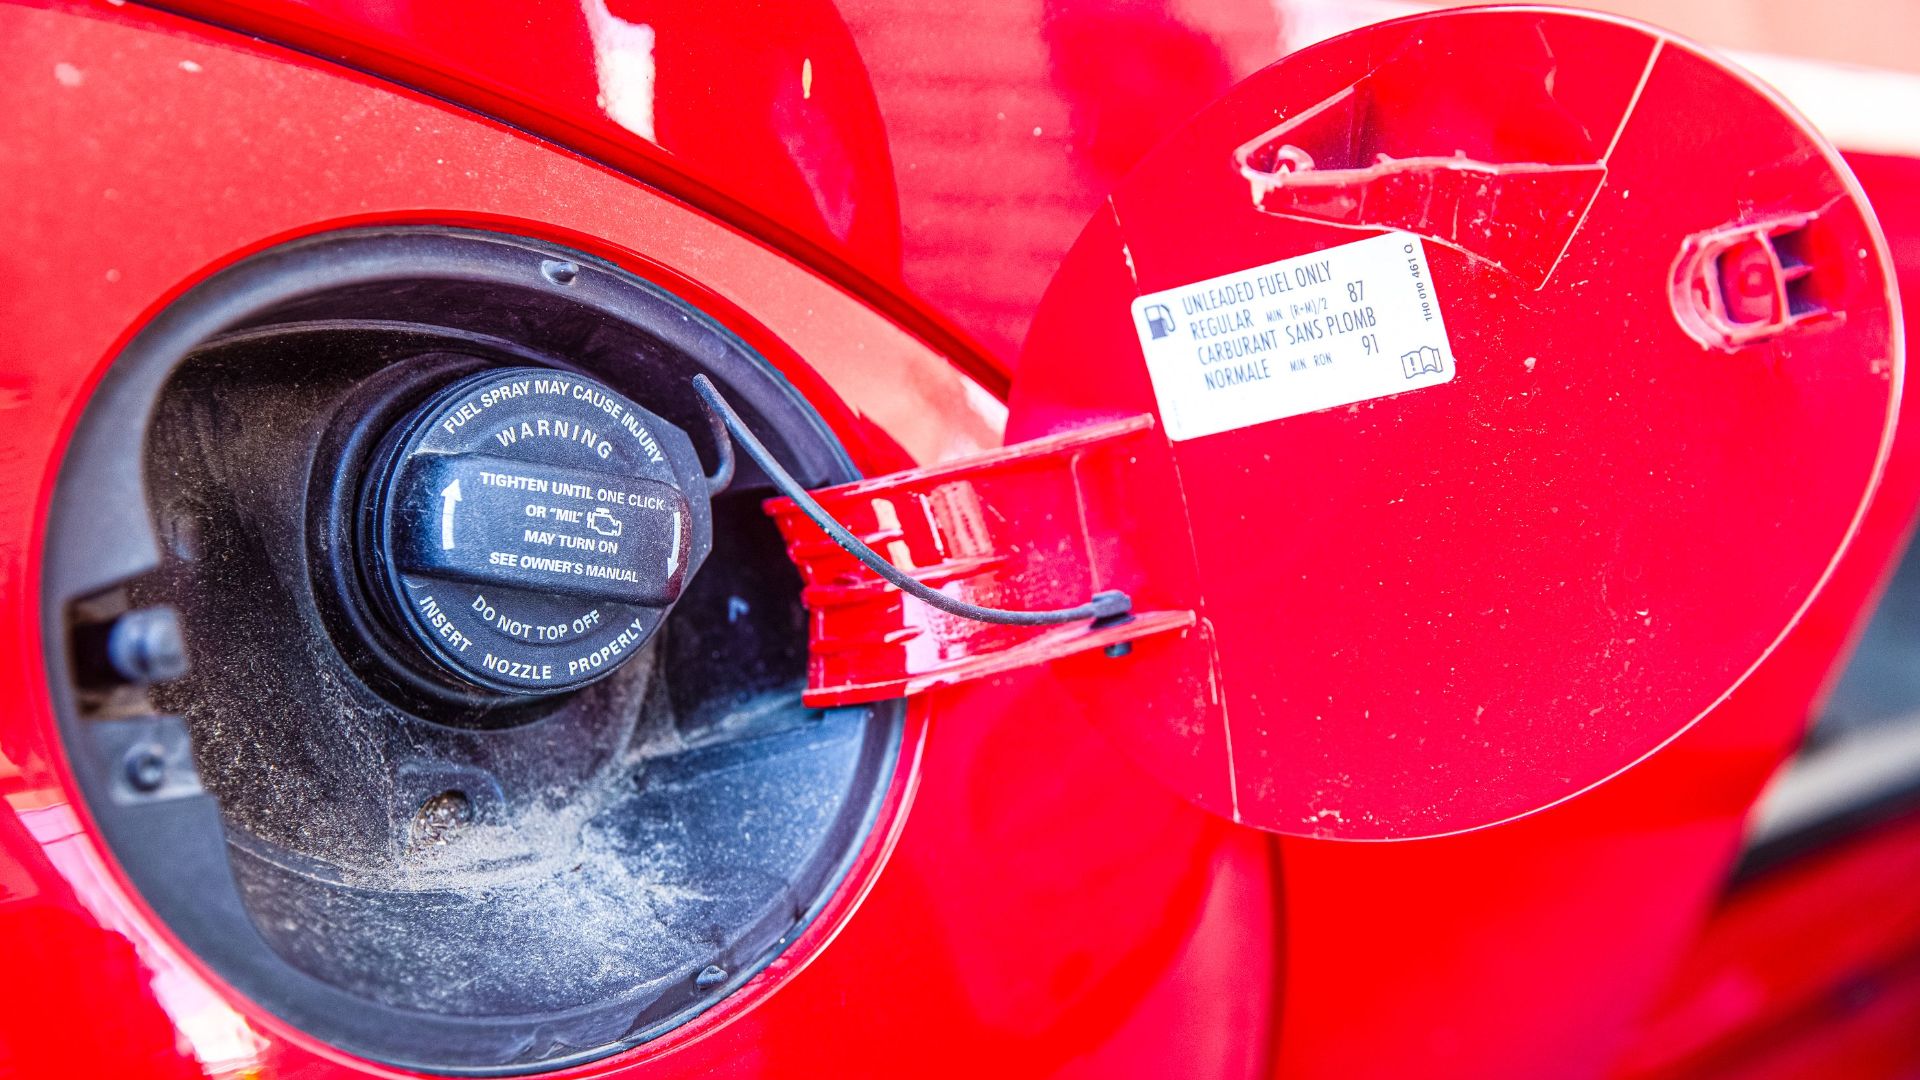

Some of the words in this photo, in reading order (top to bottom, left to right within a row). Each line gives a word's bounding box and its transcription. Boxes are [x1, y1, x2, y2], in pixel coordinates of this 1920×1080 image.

[1404, 243, 1414, 254] Q
[1408, 258, 1420, 278] 461
[1182, 281, 1254, 316] UNLEADED
[1257, 272, 1293, 297] FUEL
[1295, 260, 1333, 287] ONLY
[1416, 282, 1427, 299] 010
[1190, 309, 1254, 340] REGULAR
[1266, 309, 1284, 323] MIN
[1347, 280, 1364, 302] 87
[1197, 330, 1278, 366] CARBURANT
[1285, 319, 1323, 346] SANS
[1326, 306, 1377, 336] PLOMB
[1204, 359, 1271, 390] NORMALE
[1289, 360, 1307, 372] MIN
[1314, 352, 1333, 366] RON
[1361, 334, 1379, 355] 91
[442, 401, 482, 435] FUEL
[480, 381, 530, 408] SPRAY
[535, 380, 571, 396] MAY
[572, 384, 623, 419] CAUSE
[620, 415, 664, 464] INJURY
[496, 419, 613, 459] WARNING
[480, 472, 548, 492] TIGHTEN
[552, 481, 593, 500] UNTIL
[597, 488, 625, 504] ONE
[628, 495, 665, 510] CLICK
[525, 504, 546, 518] OR
[524, 530, 555, 545] MAY
[559, 534, 596, 551] TURN
[598, 541, 618, 554] ON
[489, 552, 518, 567] SEE
[586, 564, 639, 583] MANUAL
[419, 595, 472, 653] INSERT
[482, 653, 552, 680] NOZZLE
[568, 618, 644, 676] PROPERLY
[471, 595, 496, 621] DO
[497, 615, 533, 639] NOT
[537, 623, 568, 640] TOP
[572, 609, 600, 634] OFF
